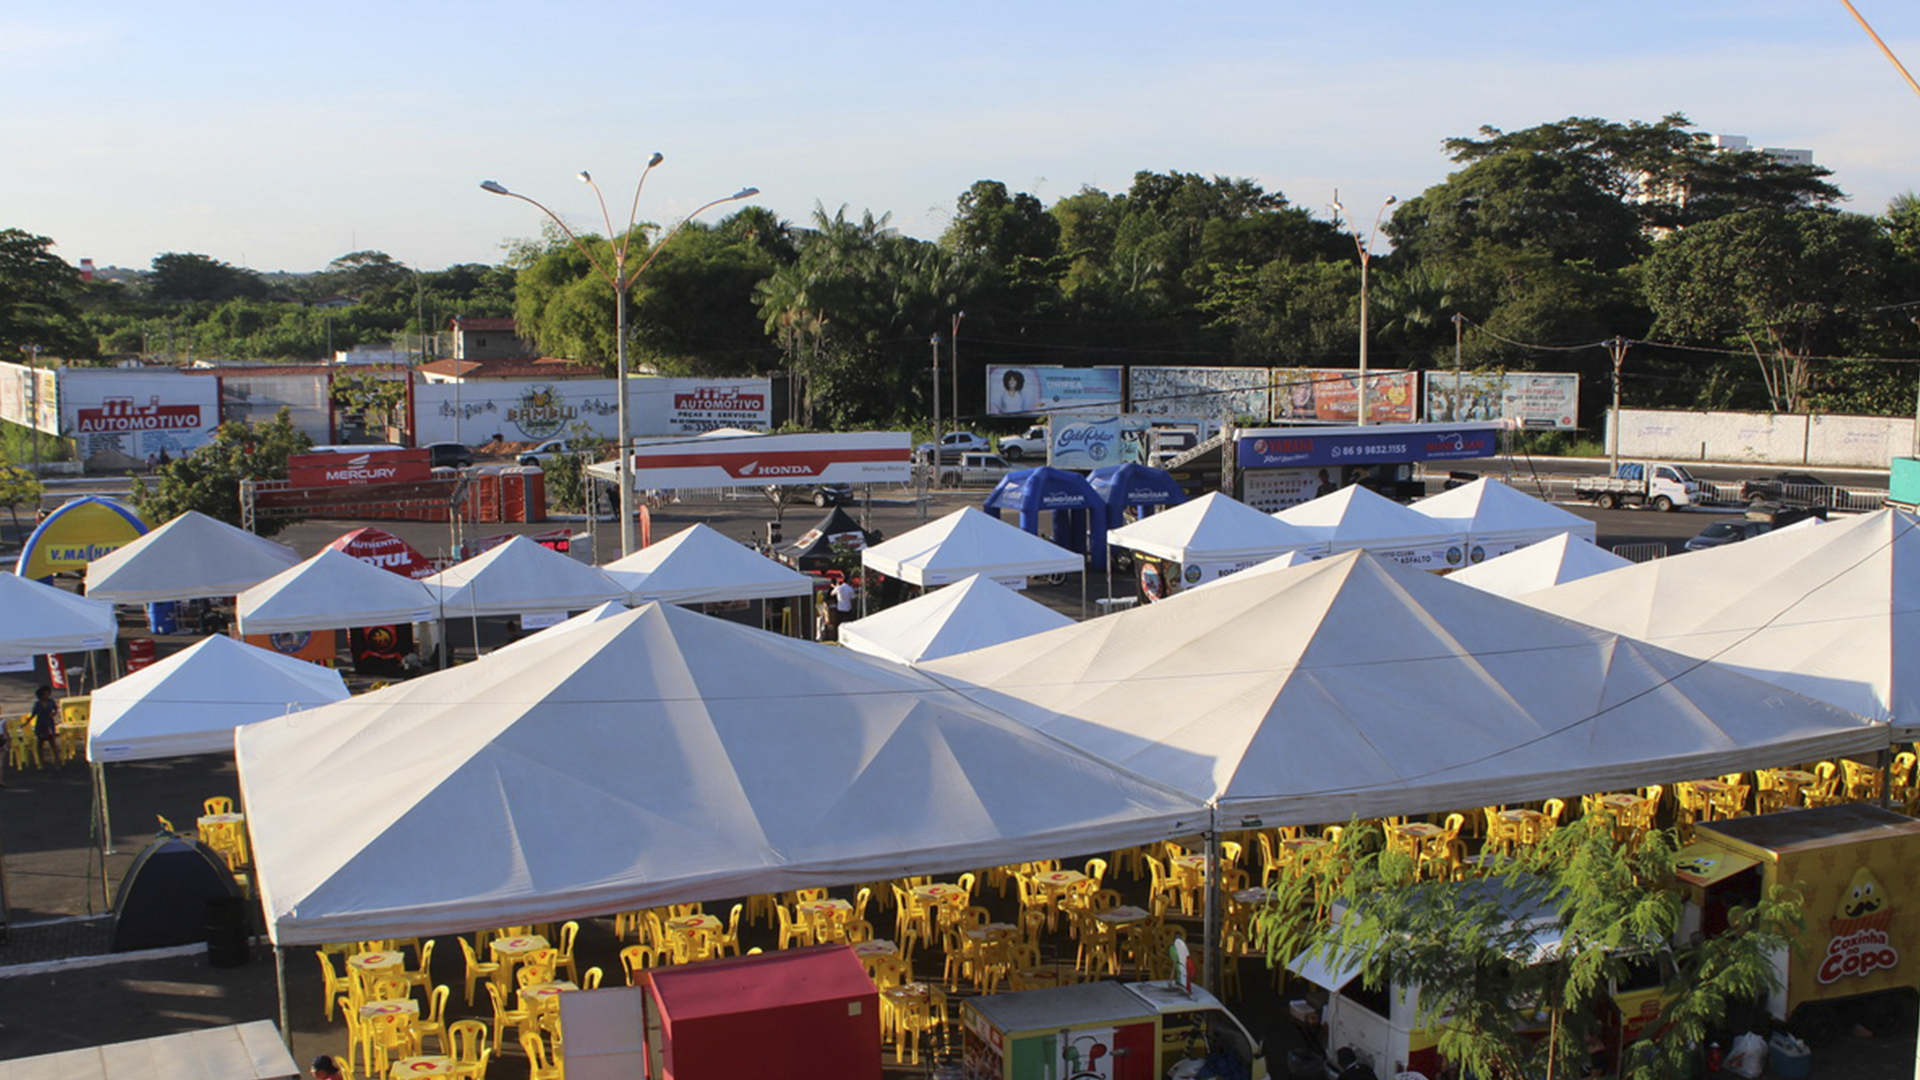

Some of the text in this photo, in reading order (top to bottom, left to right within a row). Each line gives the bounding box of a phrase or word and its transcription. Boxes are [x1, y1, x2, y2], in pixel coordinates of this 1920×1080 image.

[680, 399, 761, 411] AUTOMOTIVO
[678, 411, 702, 420] PEÇAS
[80, 414, 198, 432] AUTOMOTIVO
[1270, 439, 1314, 453] YAMAHA
[1342, 444, 1407, 456] 86 9 9832.1155
[326, 467, 397, 481] MERCURY
[758, 465, 813, 475] HONDA
[862, 465, 885, 473] Mercury
[351, 538, 402, 549] AUTHENTIC
[1401, 555, 1431, 564] ASFALTO
[1829, 931, 1887, 954] Coxinha
[1846, 946, 1860, 955] no
[1820, 949, 1896, 981] Copo
